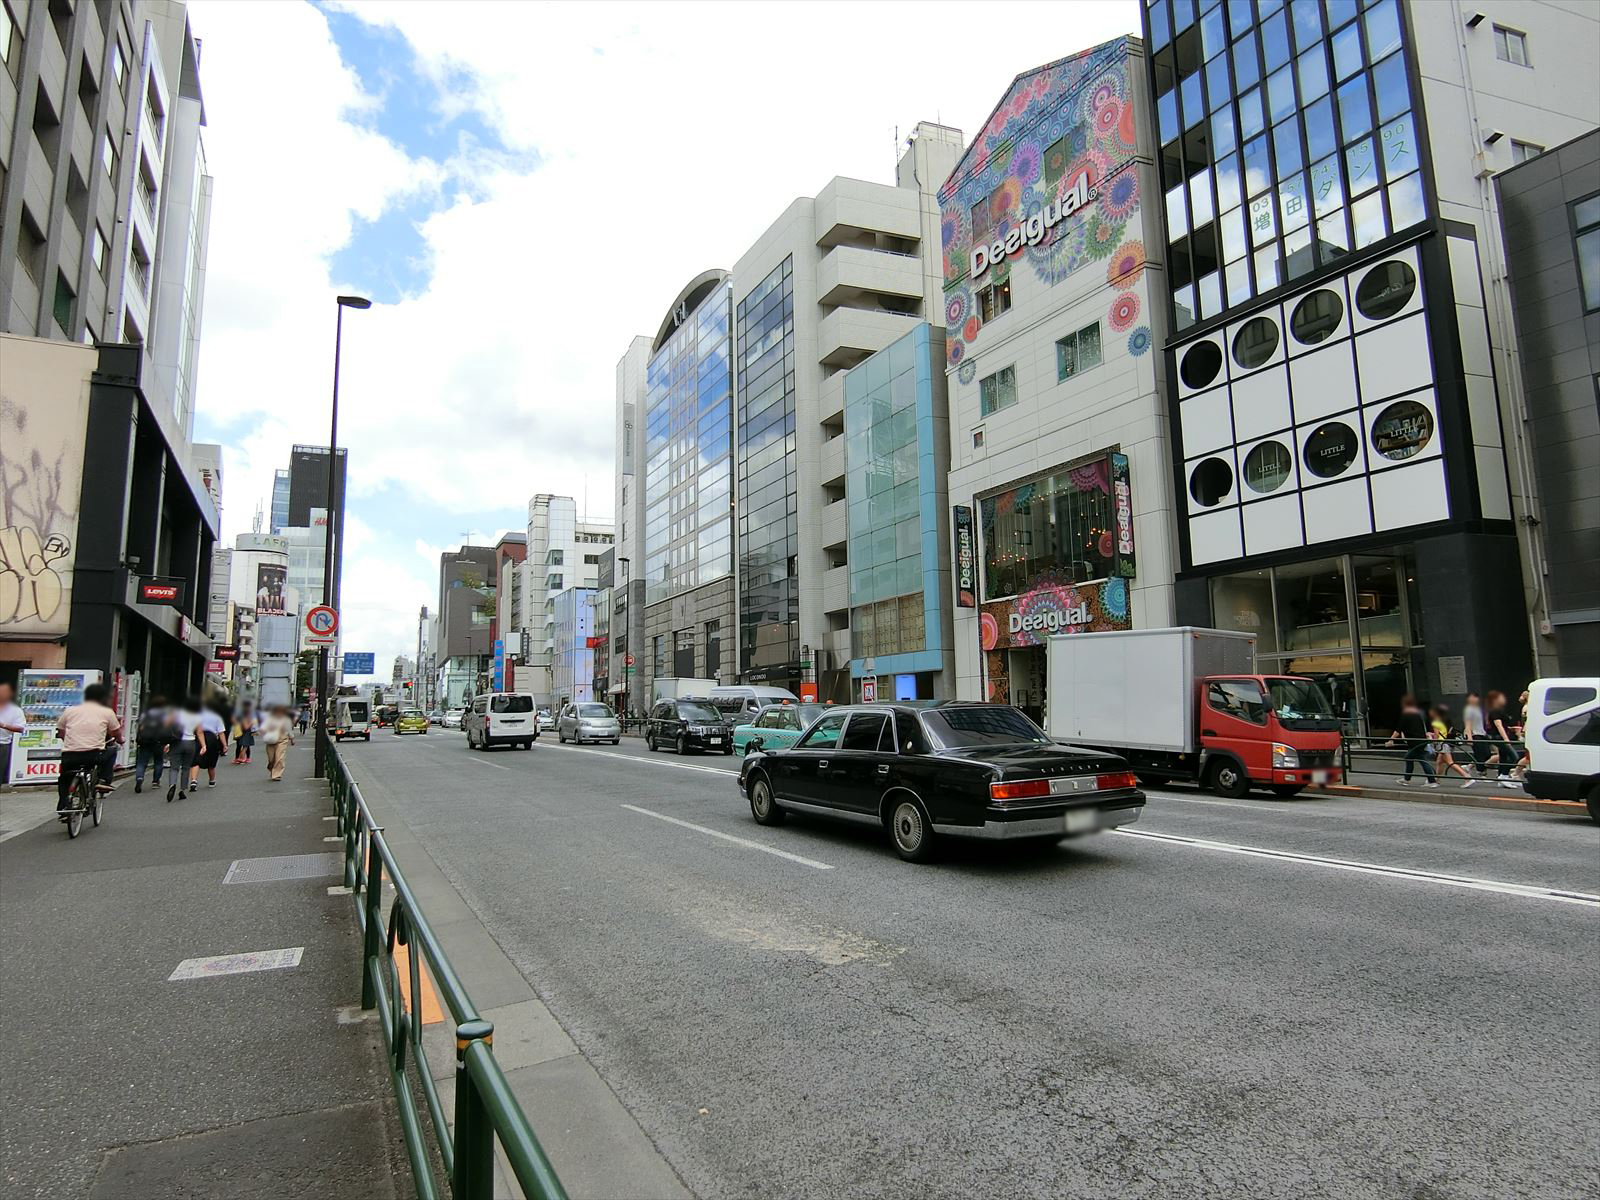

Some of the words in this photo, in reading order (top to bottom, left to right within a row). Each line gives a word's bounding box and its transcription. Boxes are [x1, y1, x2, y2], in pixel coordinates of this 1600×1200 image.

[1254, 140, 1409, 232] 増田ダンス
[1320, 444, 1346, 457] LITTLE
